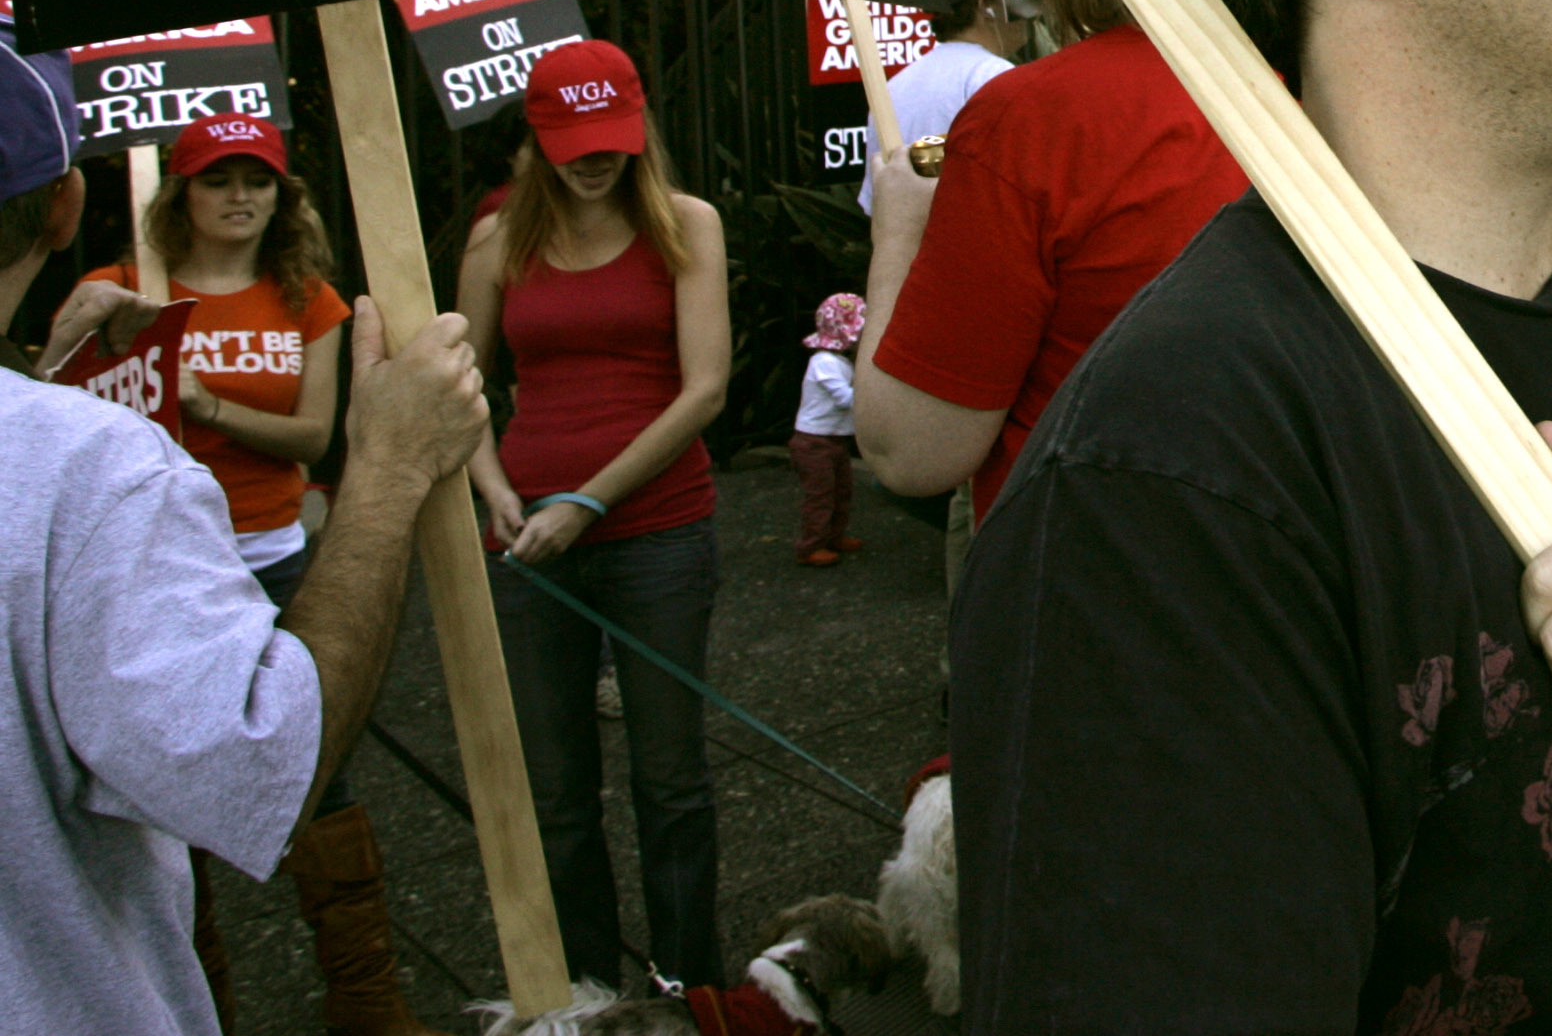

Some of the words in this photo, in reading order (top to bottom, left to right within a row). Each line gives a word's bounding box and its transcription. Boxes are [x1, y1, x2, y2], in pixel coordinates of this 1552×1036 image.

[482, 17, 524, 51] ON
[825, 15, 914, 45] GILD
[100, 61, 166, 93] ON
[558, 80, 618, 104] WGA
[206, 121, 265, 137] WGA
[262, 331, 303, 352] BE
[187, 352, 302, 375] ALOUS
